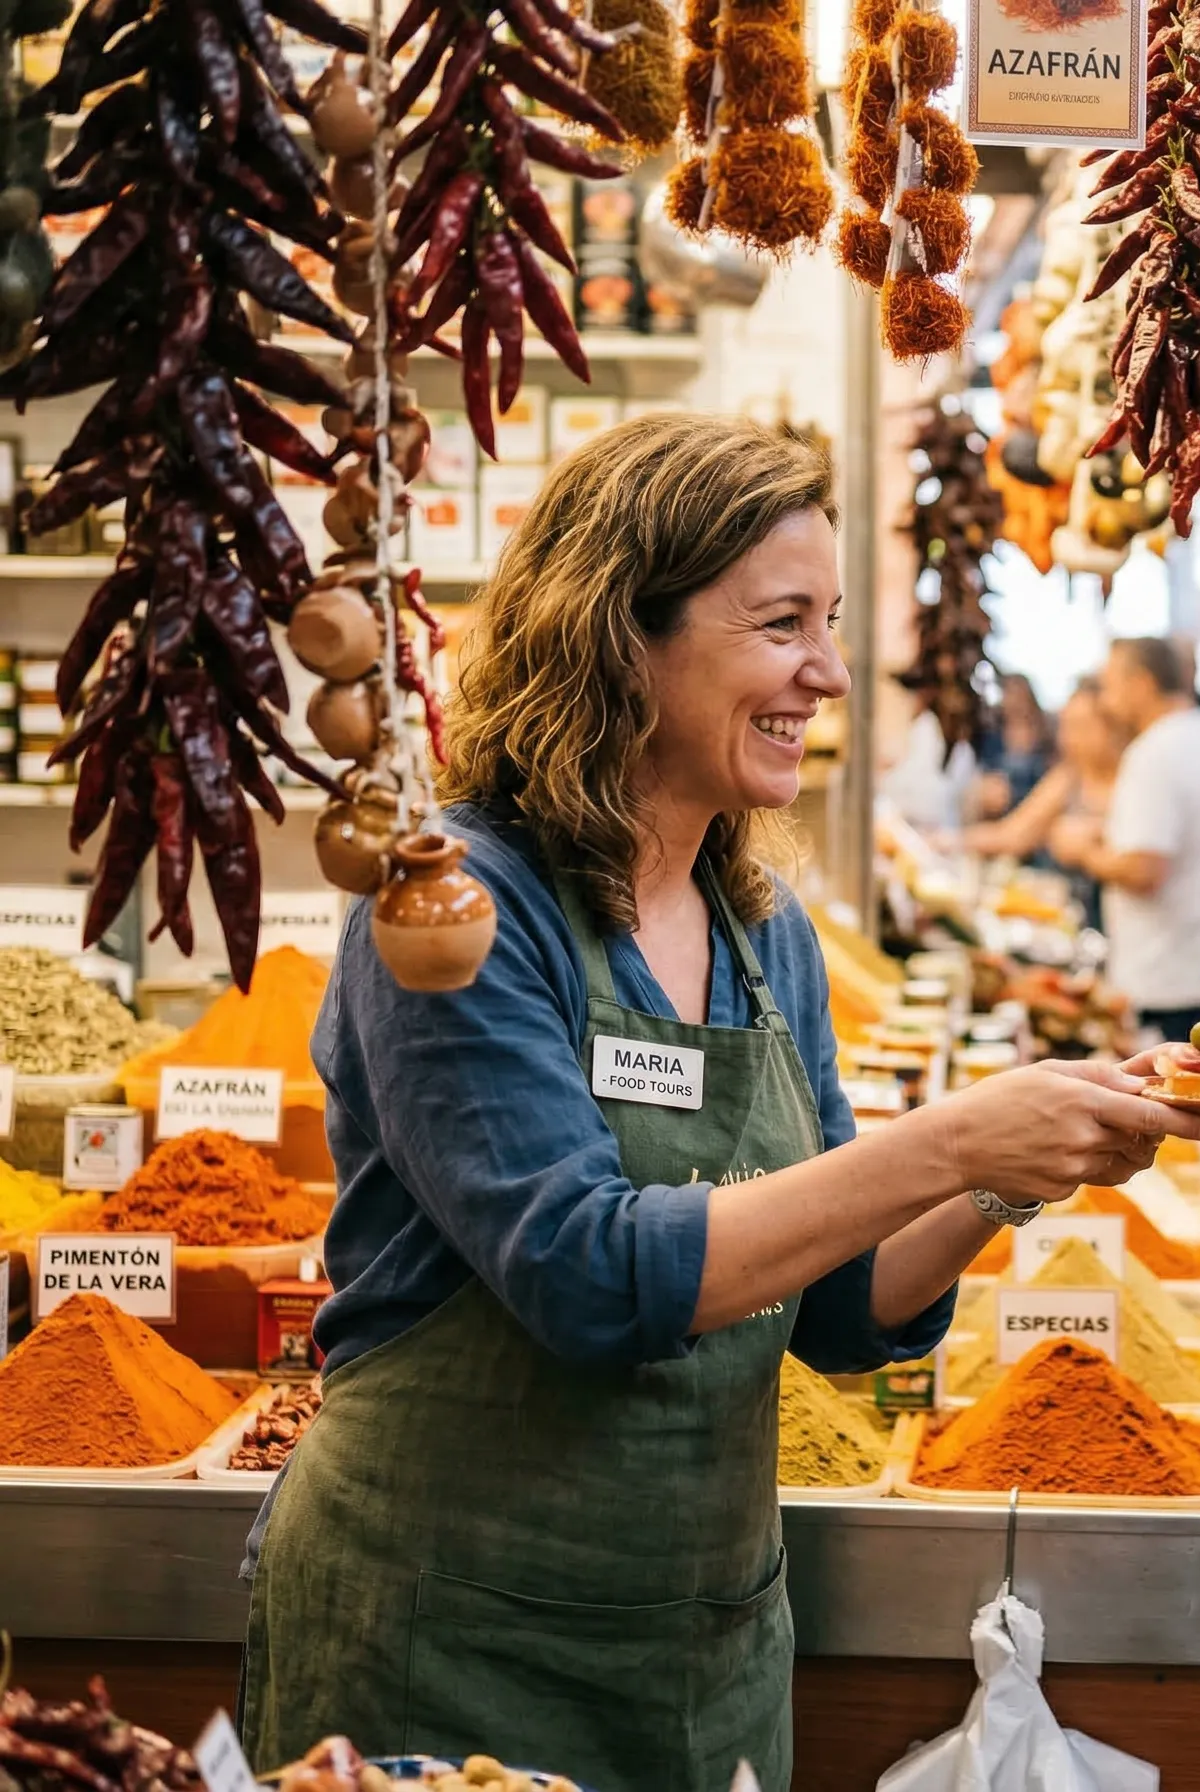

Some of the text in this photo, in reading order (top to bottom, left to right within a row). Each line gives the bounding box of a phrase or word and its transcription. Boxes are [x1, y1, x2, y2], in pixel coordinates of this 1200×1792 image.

[987, 47, 1121, 80] AZAFRÁN
[614, 1049, 684, 1076] MARIA
[173, 1078, 266, 1097] AZAFRÁN
[610, 1075, 646, 1090] FOOD
[649, 1080, 693, 1097] TOURS
[50, 1245, 161, 1266] PIMENTÓN
[44, 1274, 166, 1291] DE LA VERA
[1006, 1315, 1110, 1332] ESPECIAS
